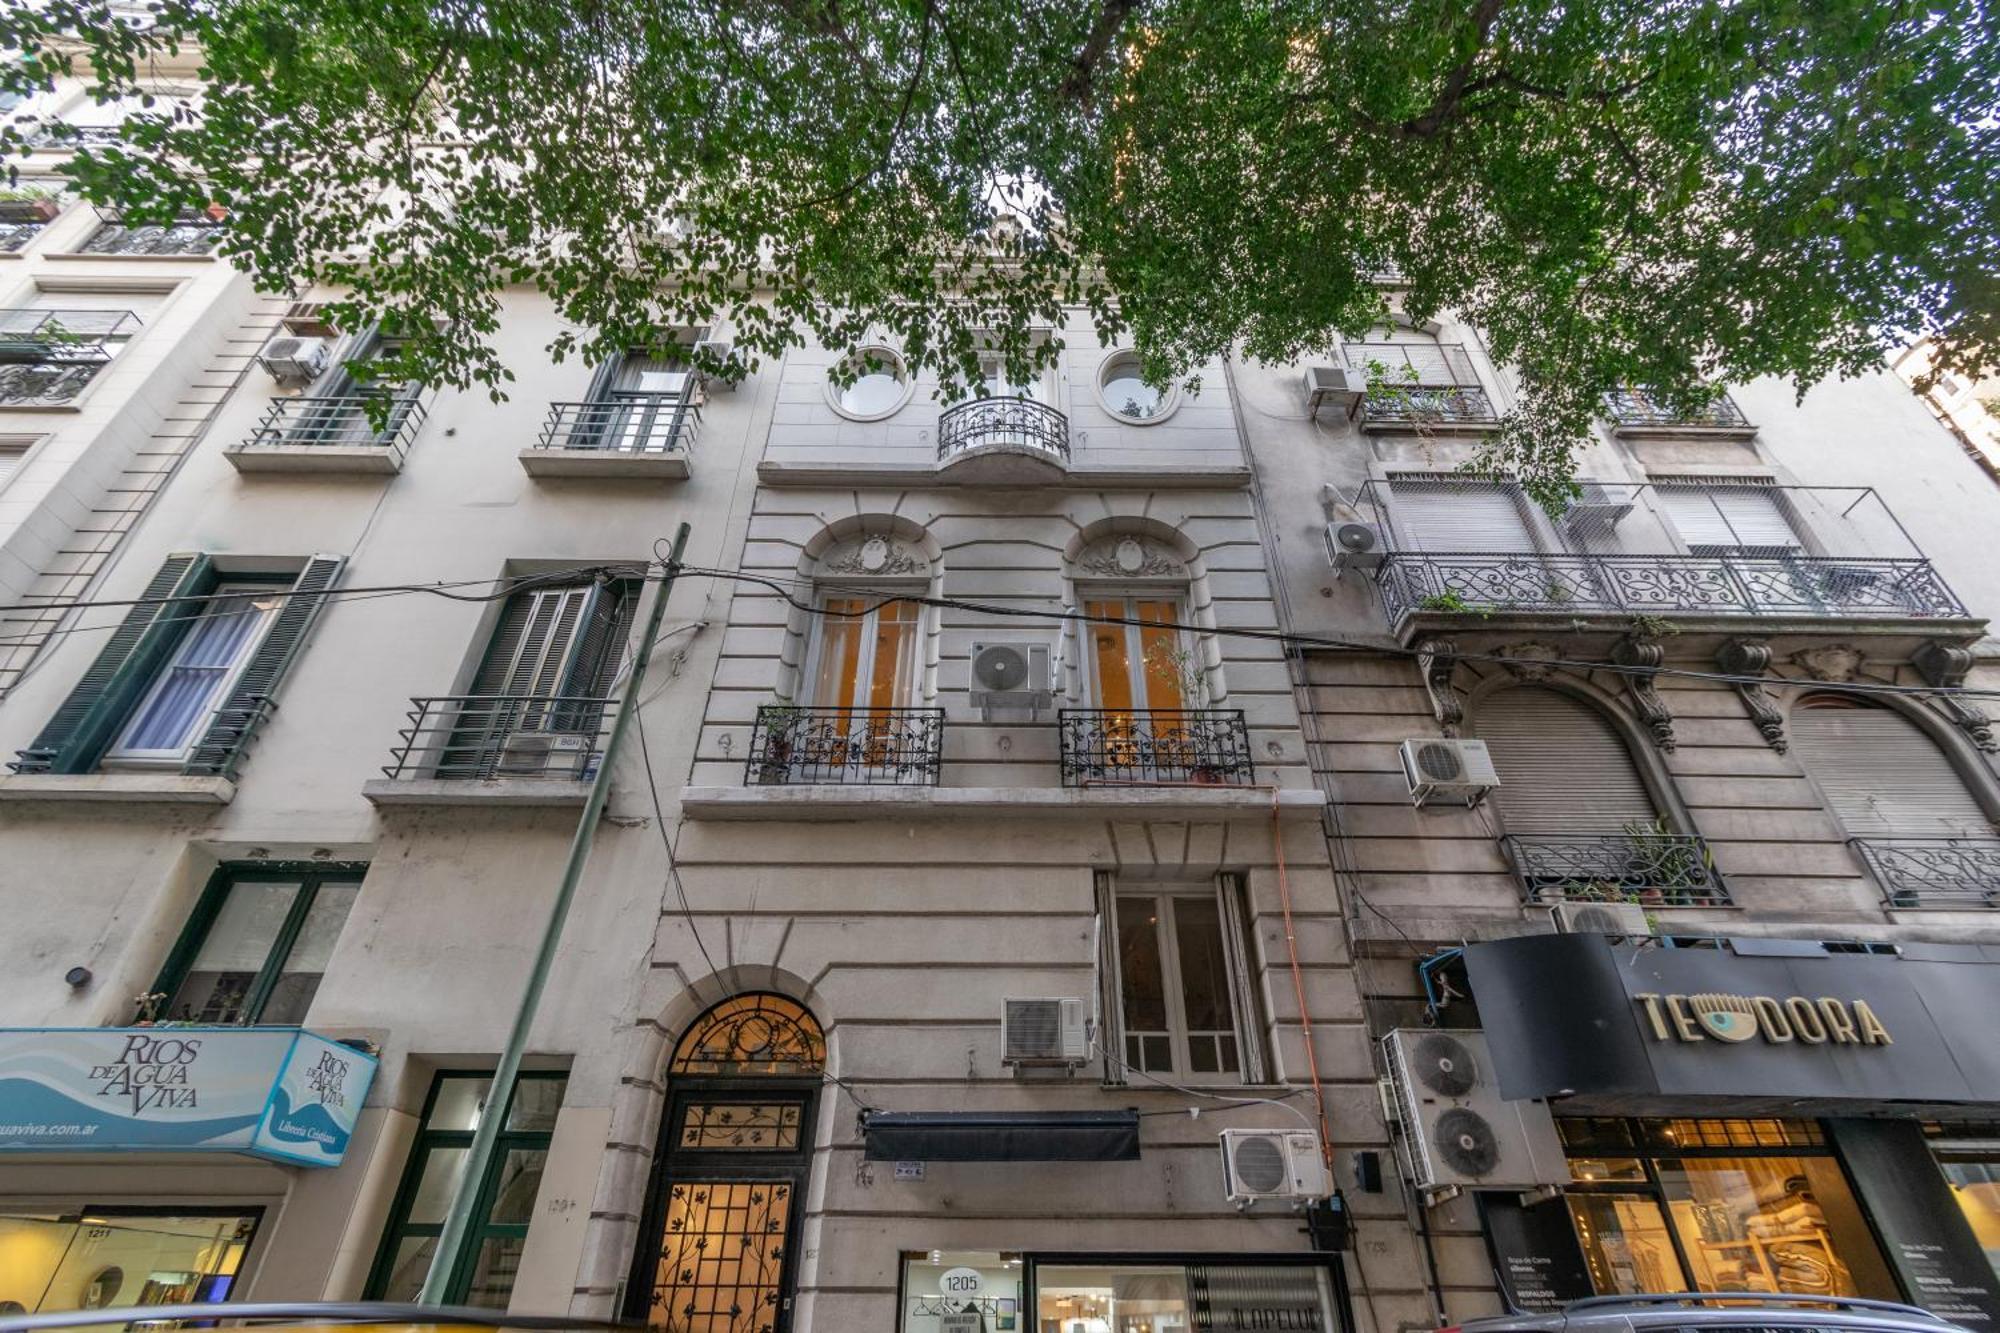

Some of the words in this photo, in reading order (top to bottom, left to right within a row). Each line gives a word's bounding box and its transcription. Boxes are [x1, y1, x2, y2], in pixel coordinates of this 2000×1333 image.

[114, 1034, 203, 1065] RIOS
[88, 1066, 119, 1079] DE
[317, 1049, 350, 1078] RIOS
[97, 1064, 188, 1096] AGUA
[308, 1070, 343, 1092] AGUA
[131, 1085, 198, 1117] VIVA
[319, 1085, 345, 1107] VIVA
[946, 1276, 977, 1291] 1205
